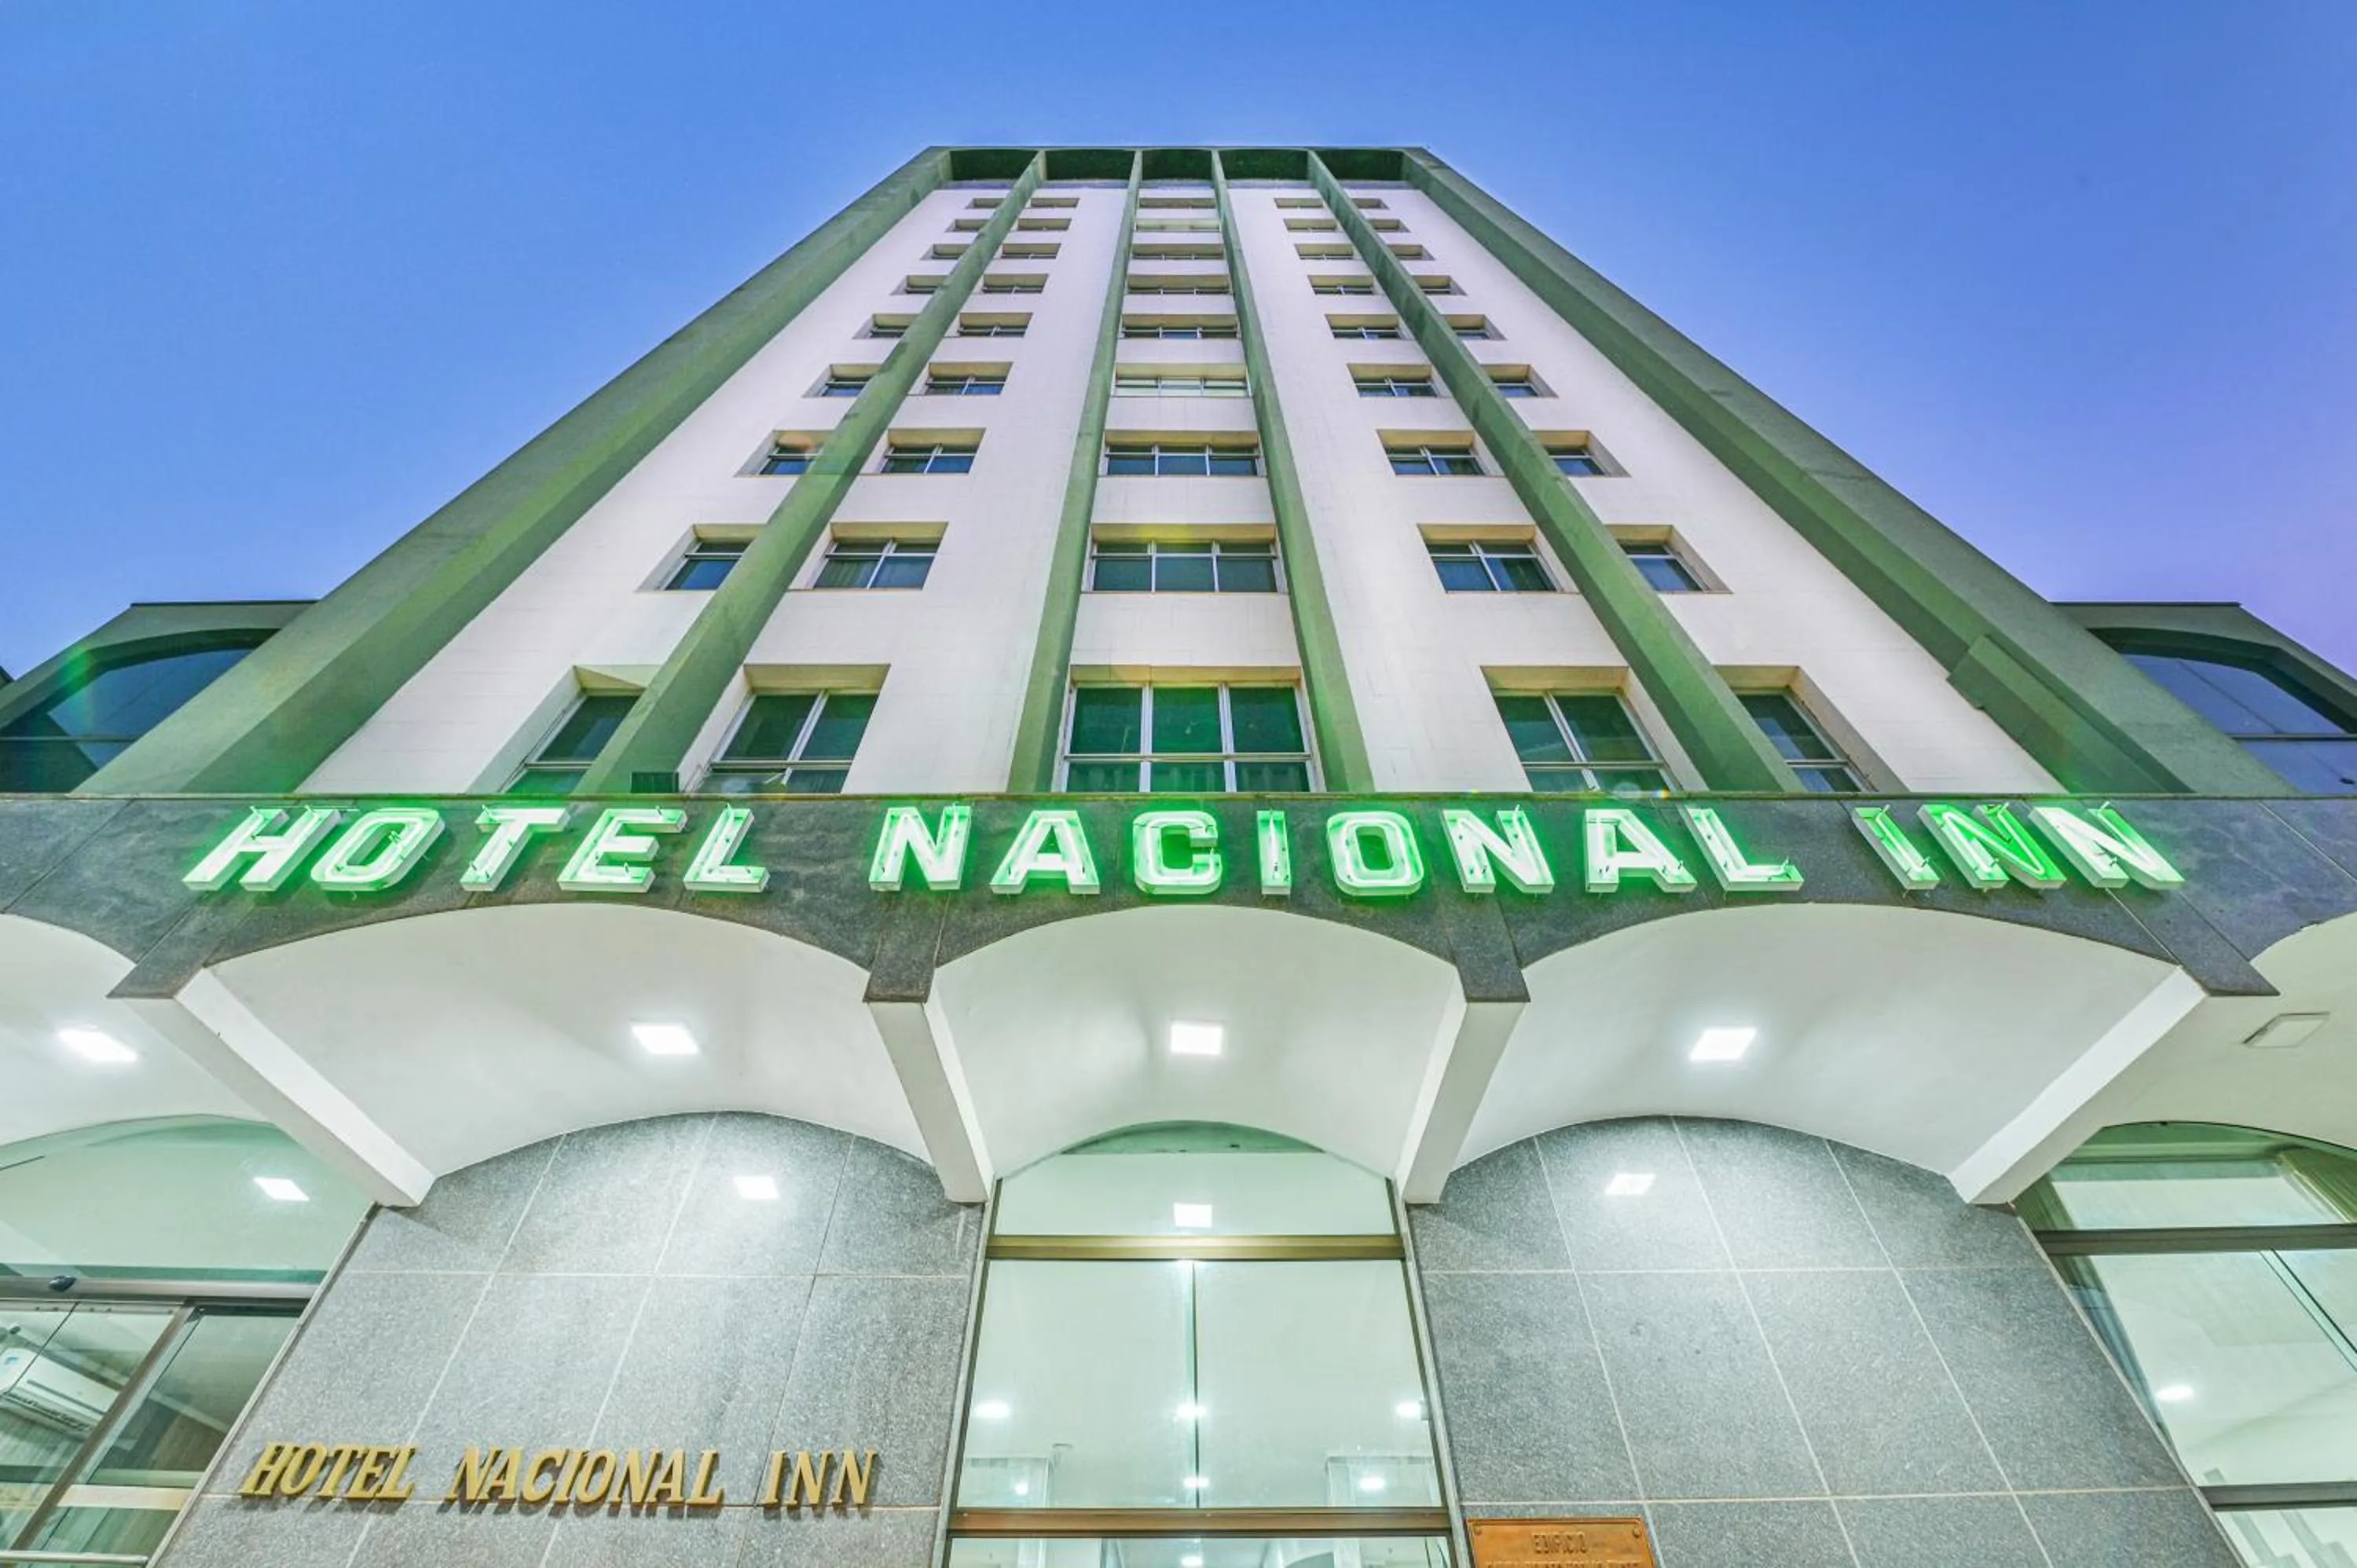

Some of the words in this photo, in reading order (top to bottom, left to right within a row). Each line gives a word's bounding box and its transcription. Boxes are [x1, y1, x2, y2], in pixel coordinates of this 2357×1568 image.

[183, 806, 772, 892] HOTEL
[868, 806, 1804, 896] NACIONAL
[1851, 808, 2185, 891] INN
[239, 1441, 419, 1500] HOTEL
[445, 1445, 725, 1506] NACIONAL
[763, 1449, 878, 1506] INN
